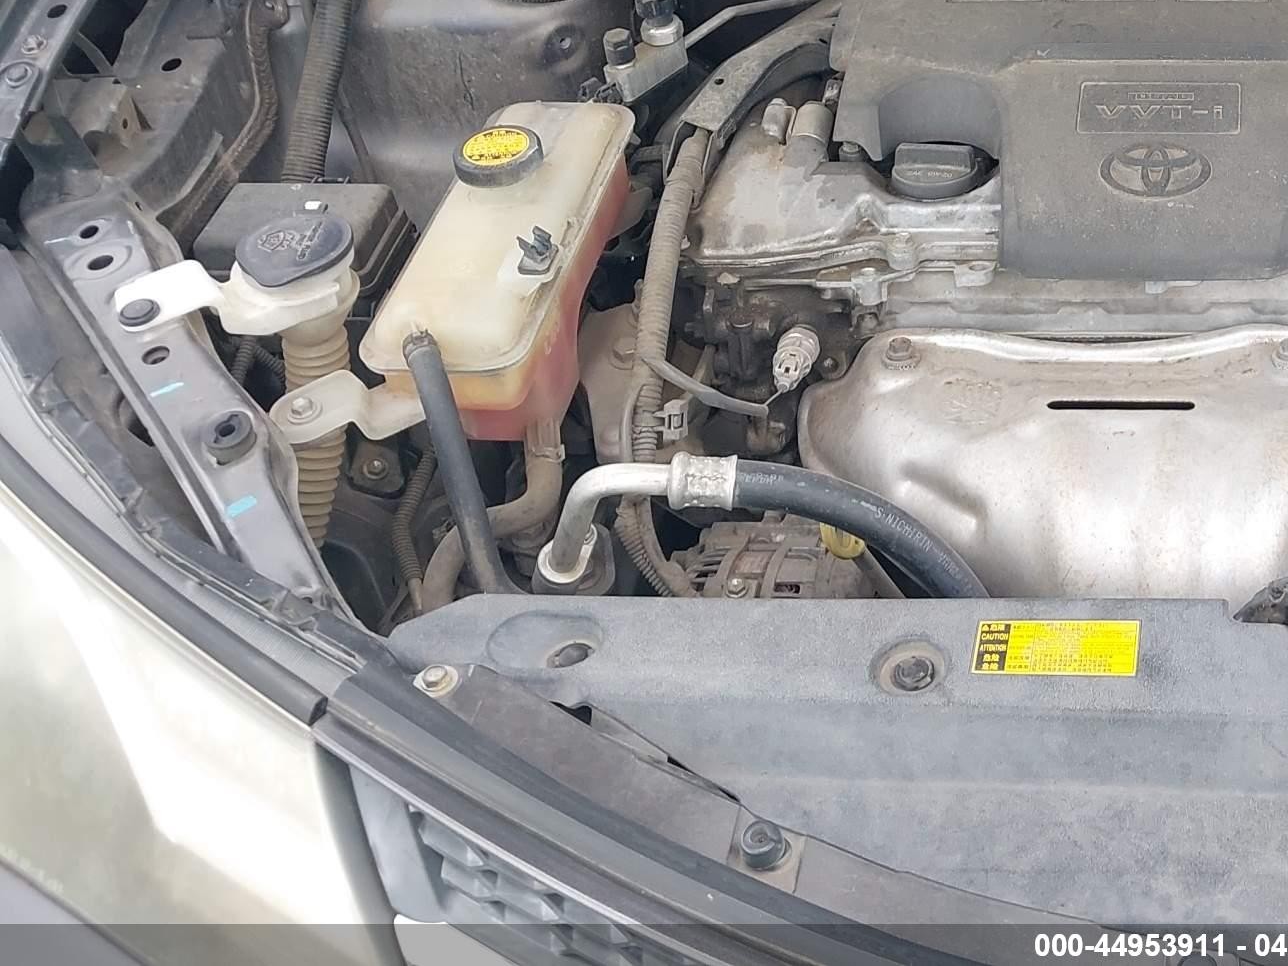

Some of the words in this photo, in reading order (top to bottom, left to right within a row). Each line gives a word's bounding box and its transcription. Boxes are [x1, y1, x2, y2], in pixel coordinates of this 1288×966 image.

[1095, 104, 1224, 120] VVT-i
[981, 632, 1009, 641] CAUTION
[979, 643, 1007, 652] ATTENTION
